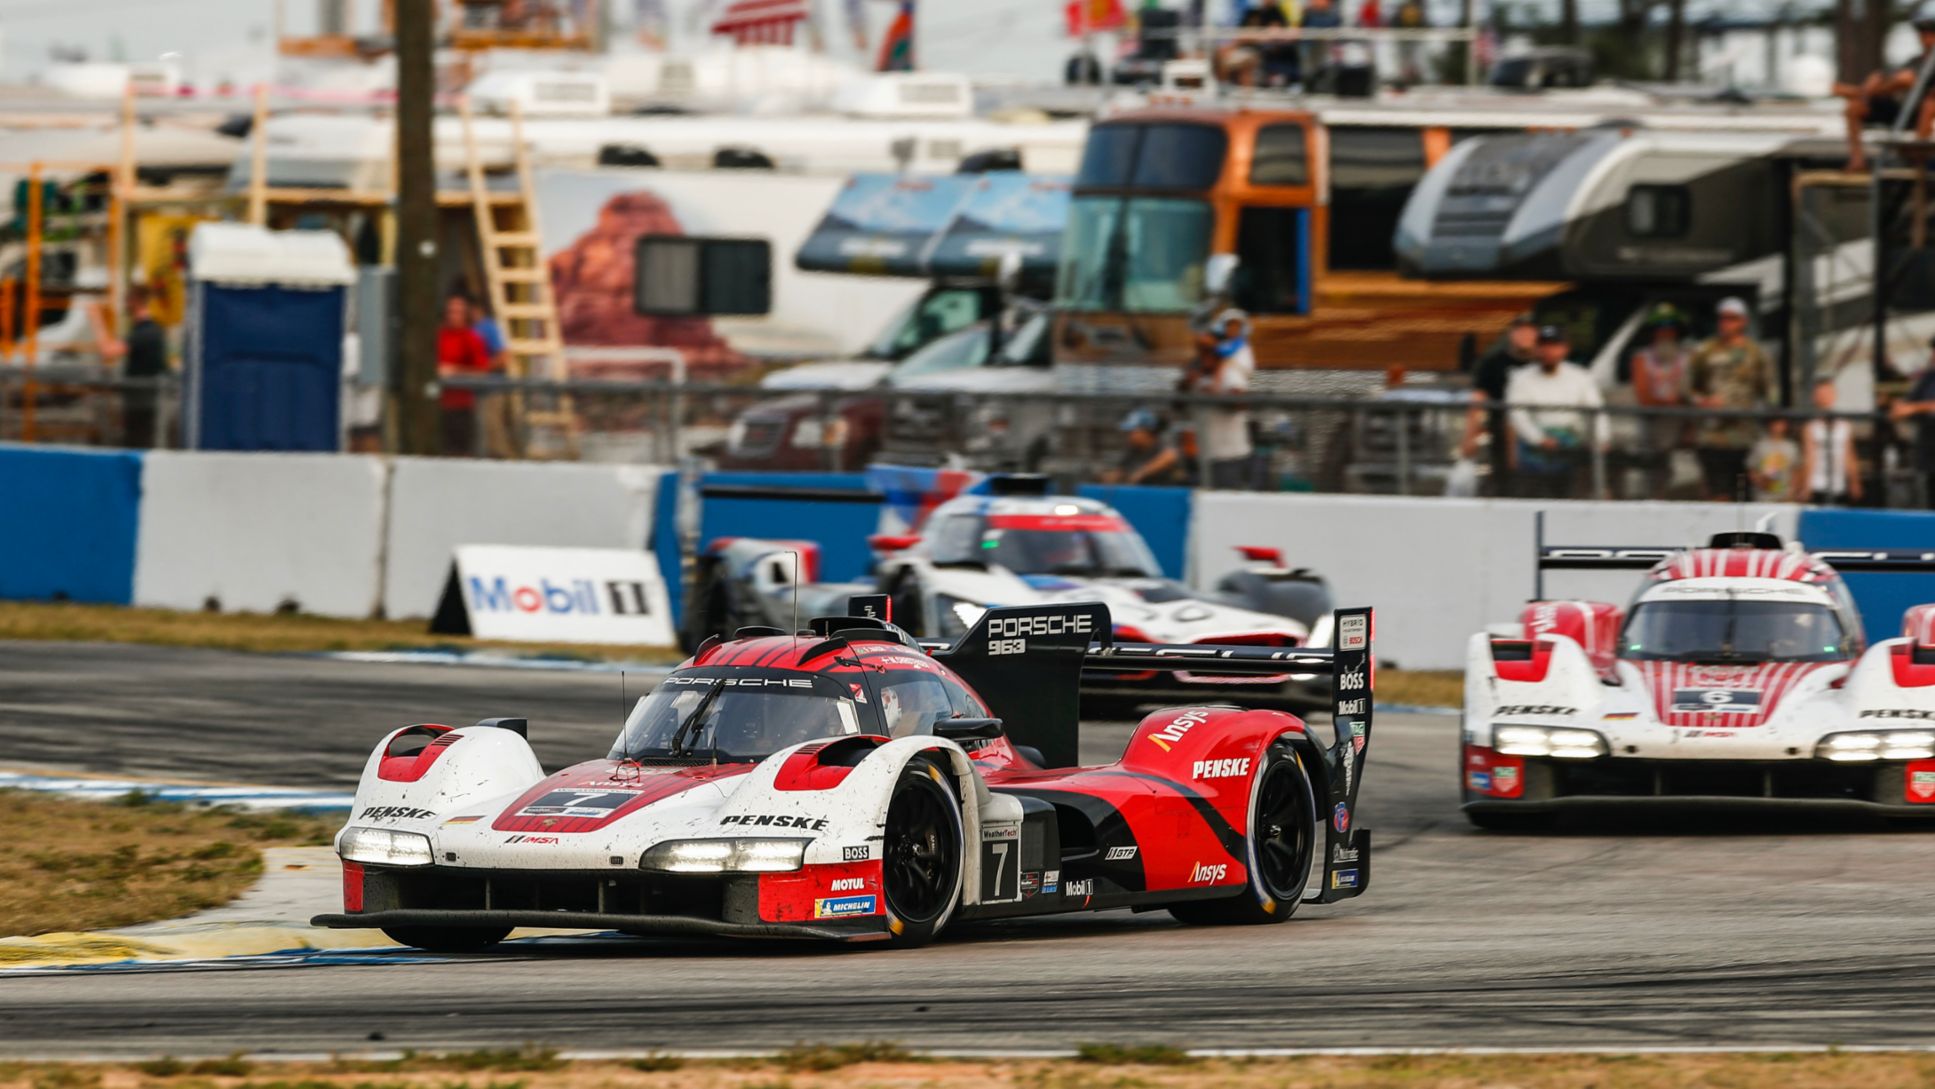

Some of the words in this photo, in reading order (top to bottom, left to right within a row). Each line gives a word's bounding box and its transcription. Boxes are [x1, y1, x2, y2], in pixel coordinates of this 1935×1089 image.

[470, 576, 600, 615] Mobil
[987, 614, 1093, 639] PORSCHE
[987, 639, 1026, 656] 963
[663, 676, 813, 689] PORSCHE
[1340, 672, 1364, 691] BOSS
[1701, 690, 1734, 704] 6
[1338, 699, 1358, 716] Mobil
[1357, 697, 1366, 714] 1
[1147, 709, 1209, 753] Ansys
[1192, 757, 1251, 780] PENSKE
[562, 792, 608, 806] 7
[358, 806, 437, 820] PENSKE
[720, 815, 829, 831] PENSKE
[844, 848, 868, 860] BOSS
[992, 842, 1009, 897] 7
[1187, 860, 1228, 886] Ansys
[831, 878, 865, 891] MOTUL
[1066, 879, 1086, 896] Mobil
[1085, 878, 1094, 896] 1
[833, 901, 870, 912] MICHELIN
